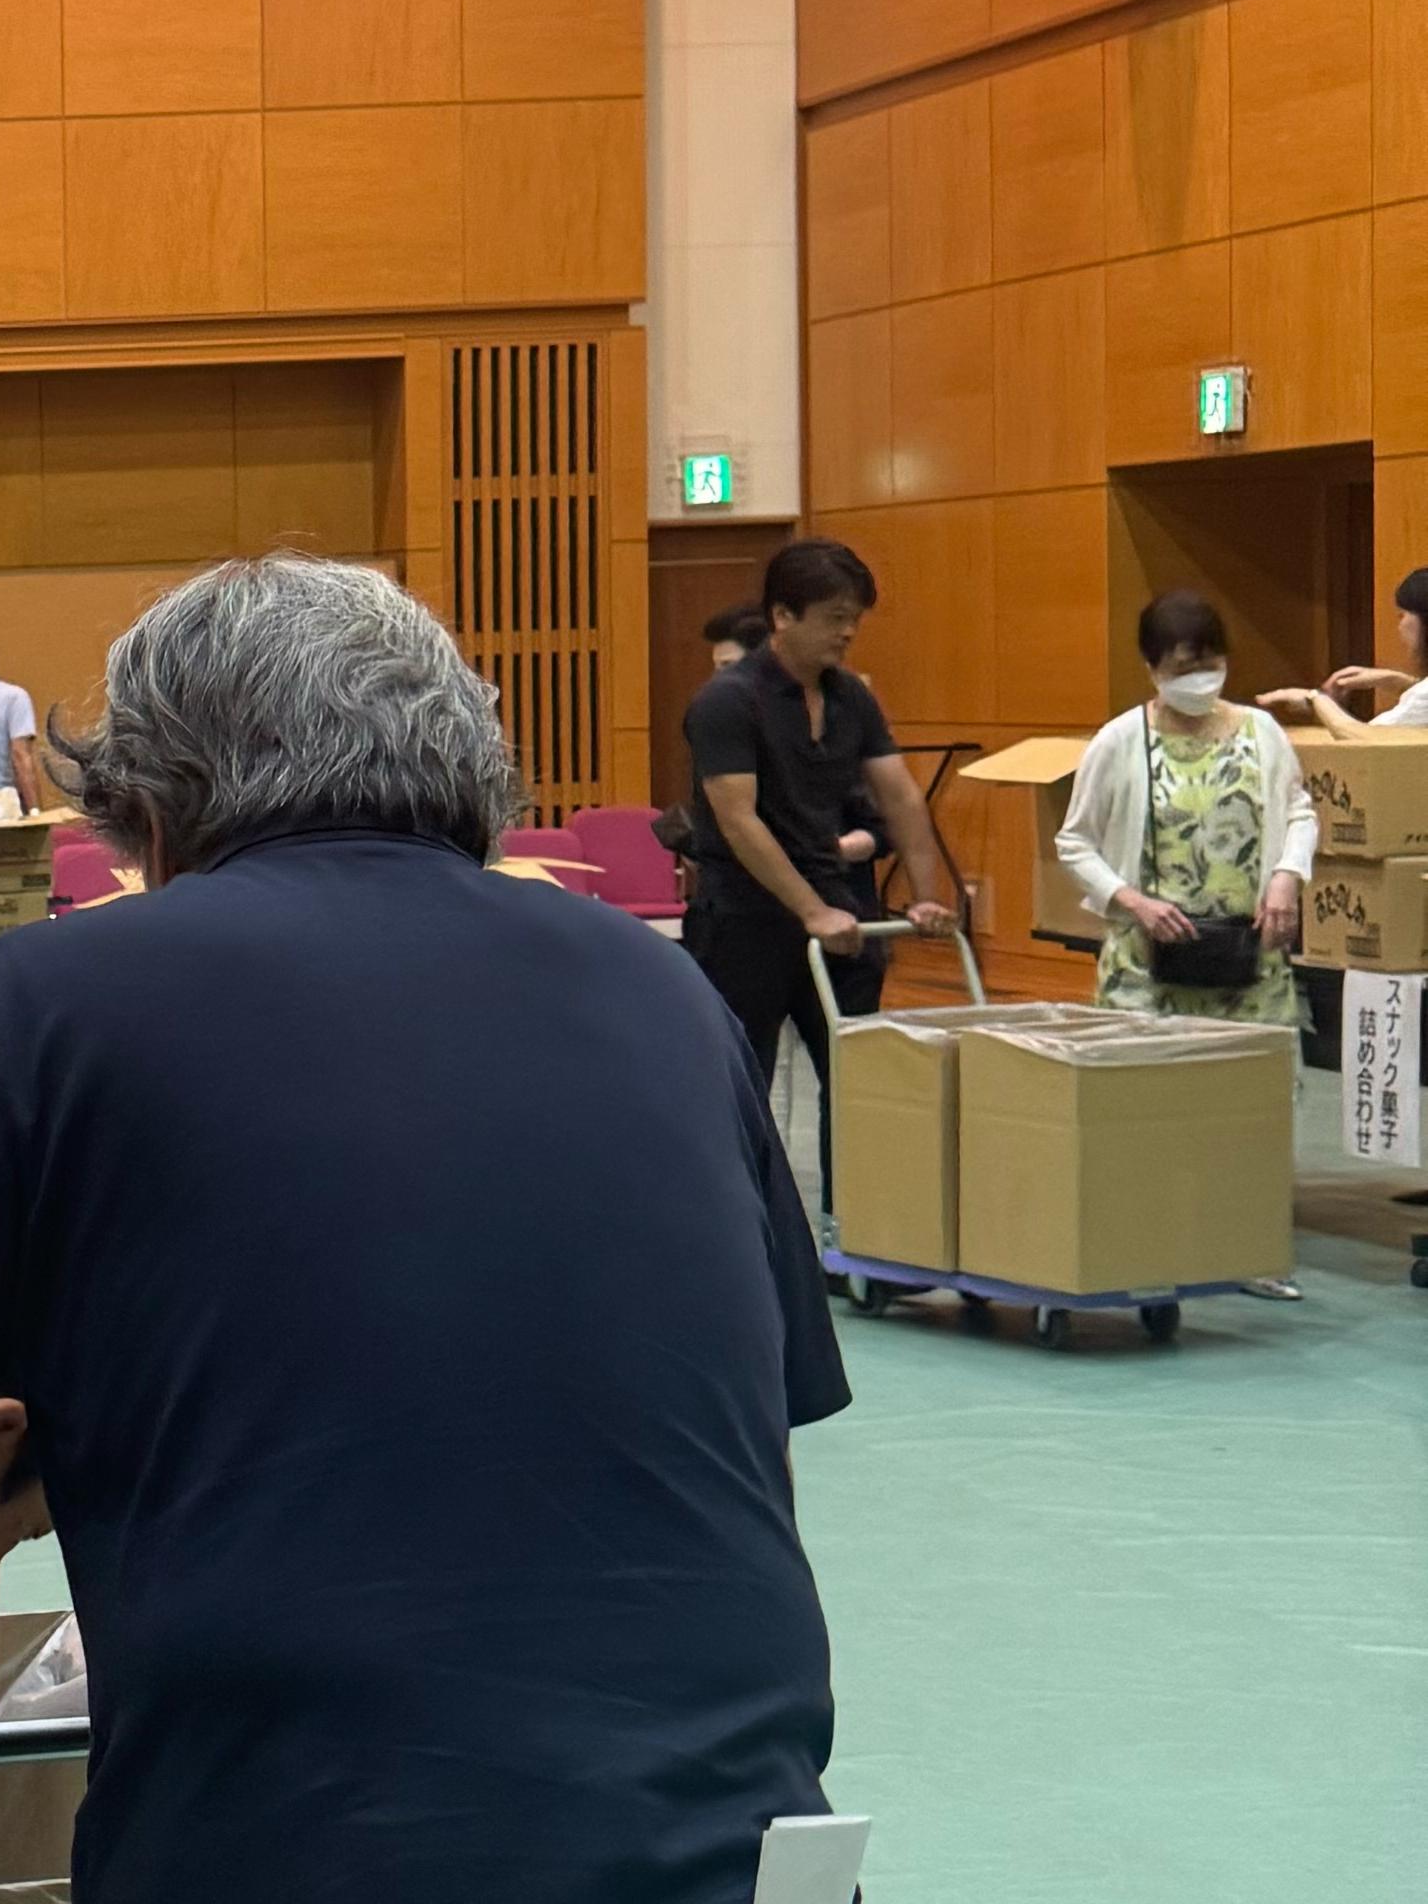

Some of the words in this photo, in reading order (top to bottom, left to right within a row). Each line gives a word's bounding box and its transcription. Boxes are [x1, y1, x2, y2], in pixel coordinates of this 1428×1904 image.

[1355, 1007, 1377, 1154] 詰め合わせ
[1380, 980, 1402, 1149] スナック菓子
